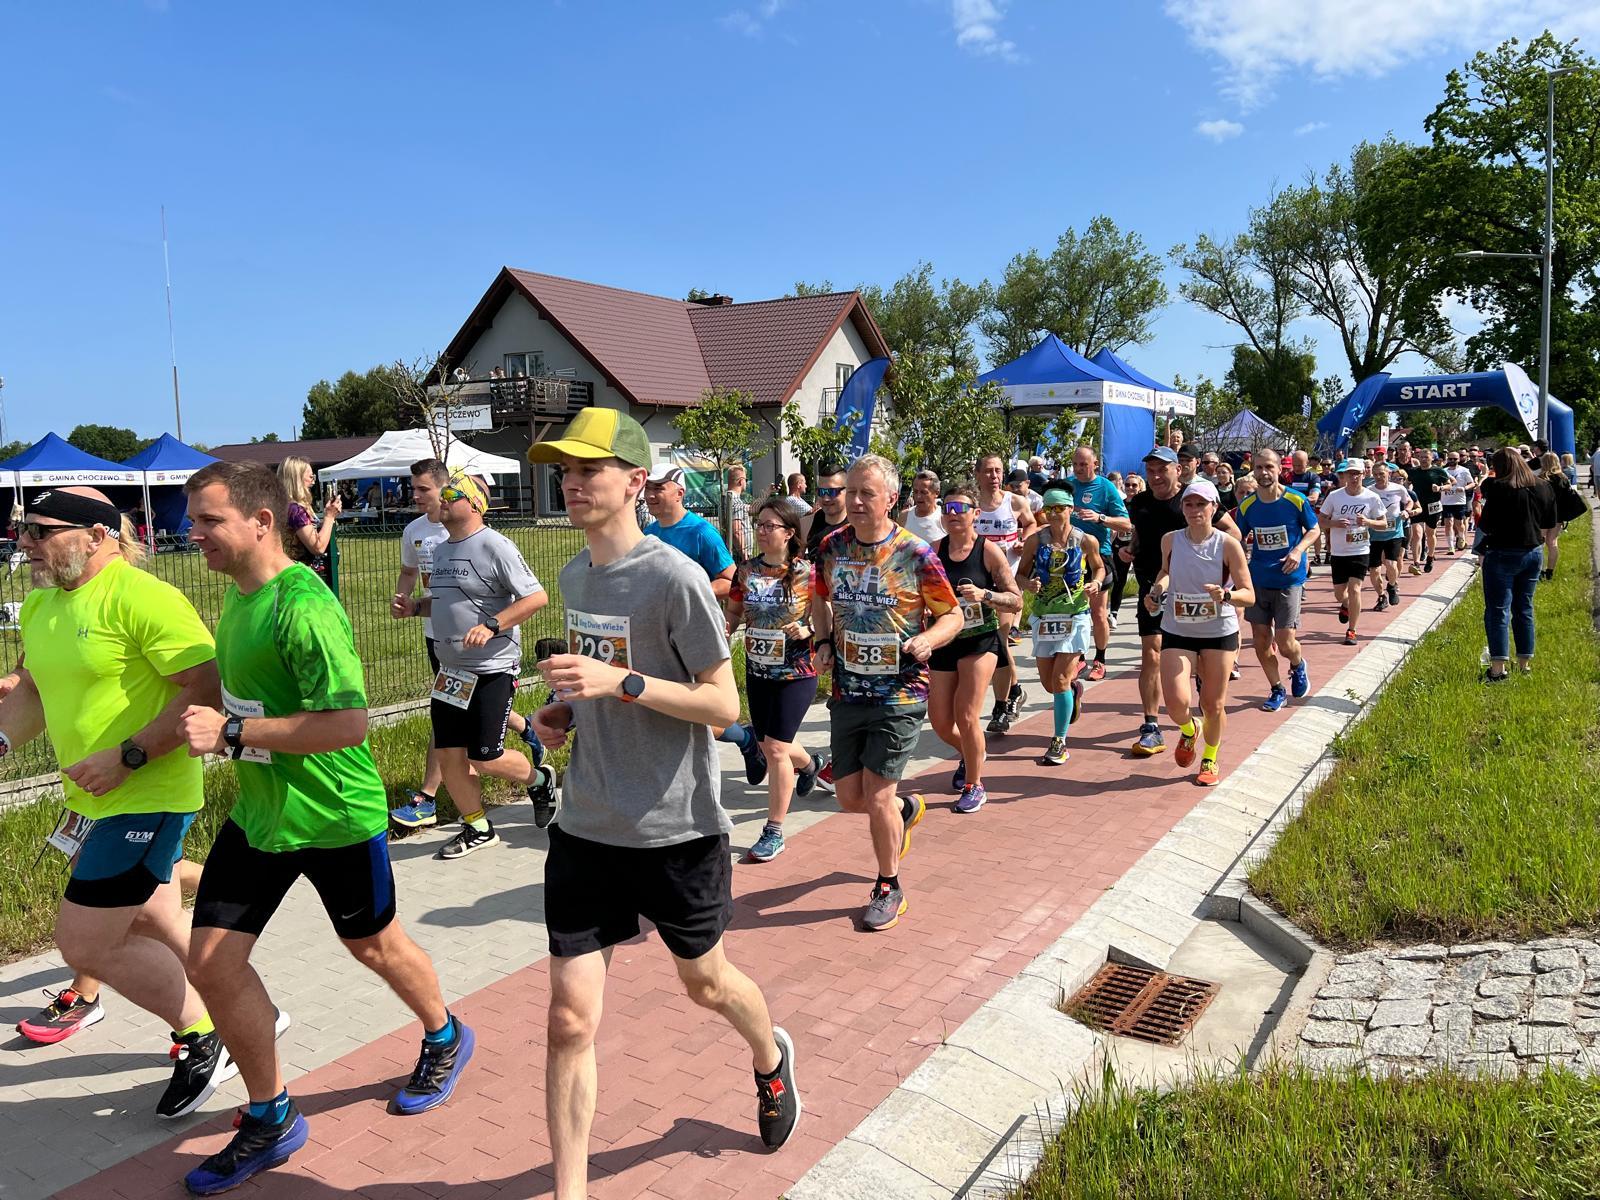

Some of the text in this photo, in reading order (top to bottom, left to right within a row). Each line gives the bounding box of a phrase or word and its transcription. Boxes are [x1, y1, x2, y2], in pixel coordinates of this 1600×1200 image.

[1400, 382, 1471, 400] START
[1261, 534, 1282, 545] 183
[453, 567, 469, 577] Hub
[1181, 603, 1209, 616] 176
[601, 622, 625, 632] Wieże
[1042, 622, 1067, 634] 115
[575, 634, 615, 665] 229
[750, 639, 777, 655] 237
[857, 646, 882, 664] 58
[445, 677, 463, 695] 99
[125, 831, 155, 840] GYM
